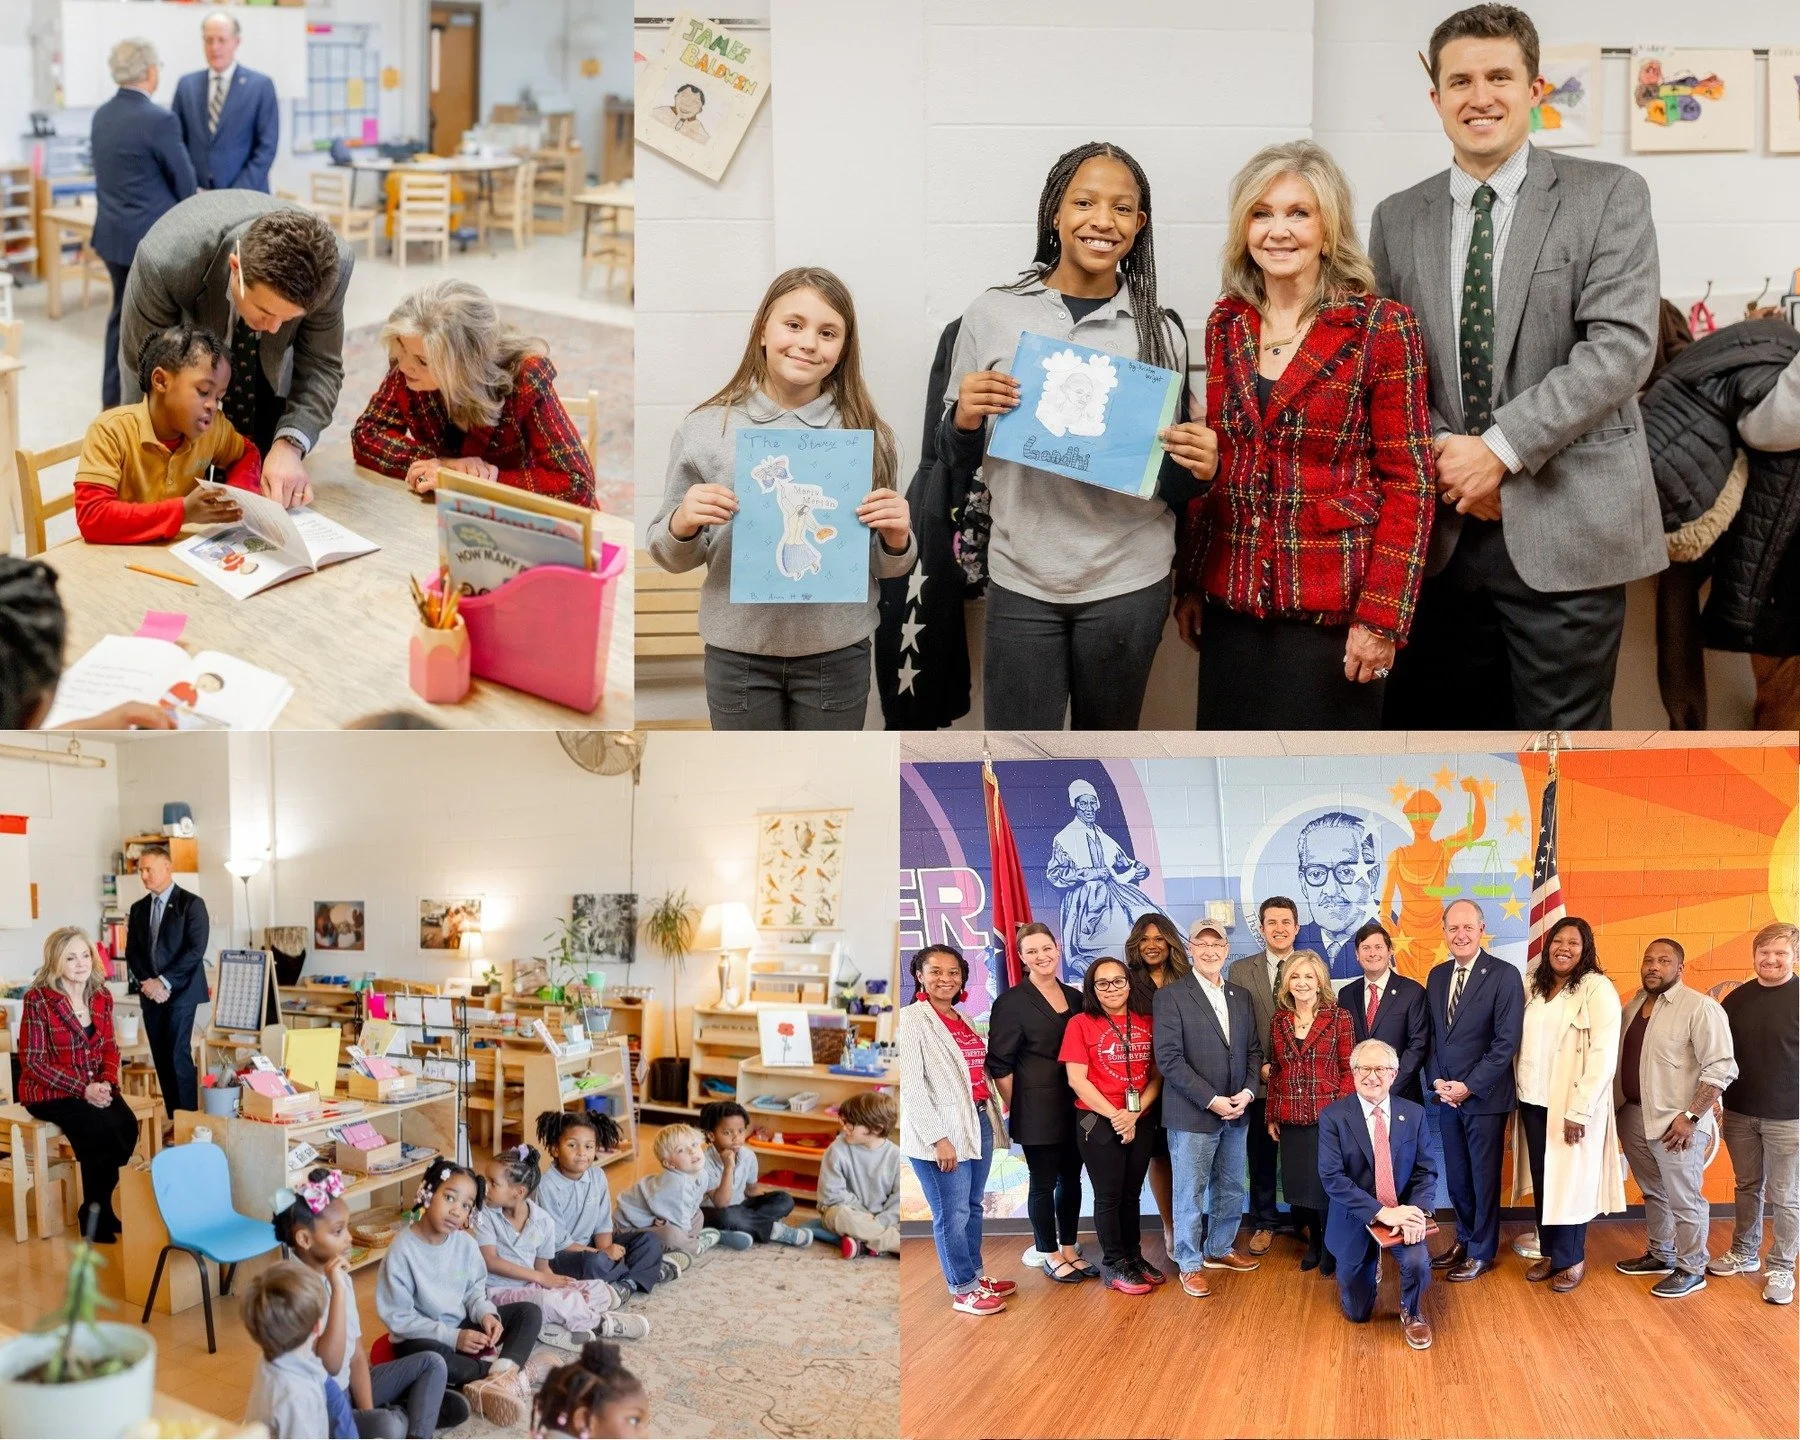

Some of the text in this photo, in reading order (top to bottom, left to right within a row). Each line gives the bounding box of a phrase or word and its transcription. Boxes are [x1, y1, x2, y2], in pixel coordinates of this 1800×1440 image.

[682, 19, 751, 64] JAMES
[680, 43, 758, 96] BALDWIN
[744, 432, 860, 452] The Story of
[1023, 435, 1090, 471] Gandhi
[456, 549, 517, 571] HOW MANY
[1246, 911, 1266, 949] Thurgoo
